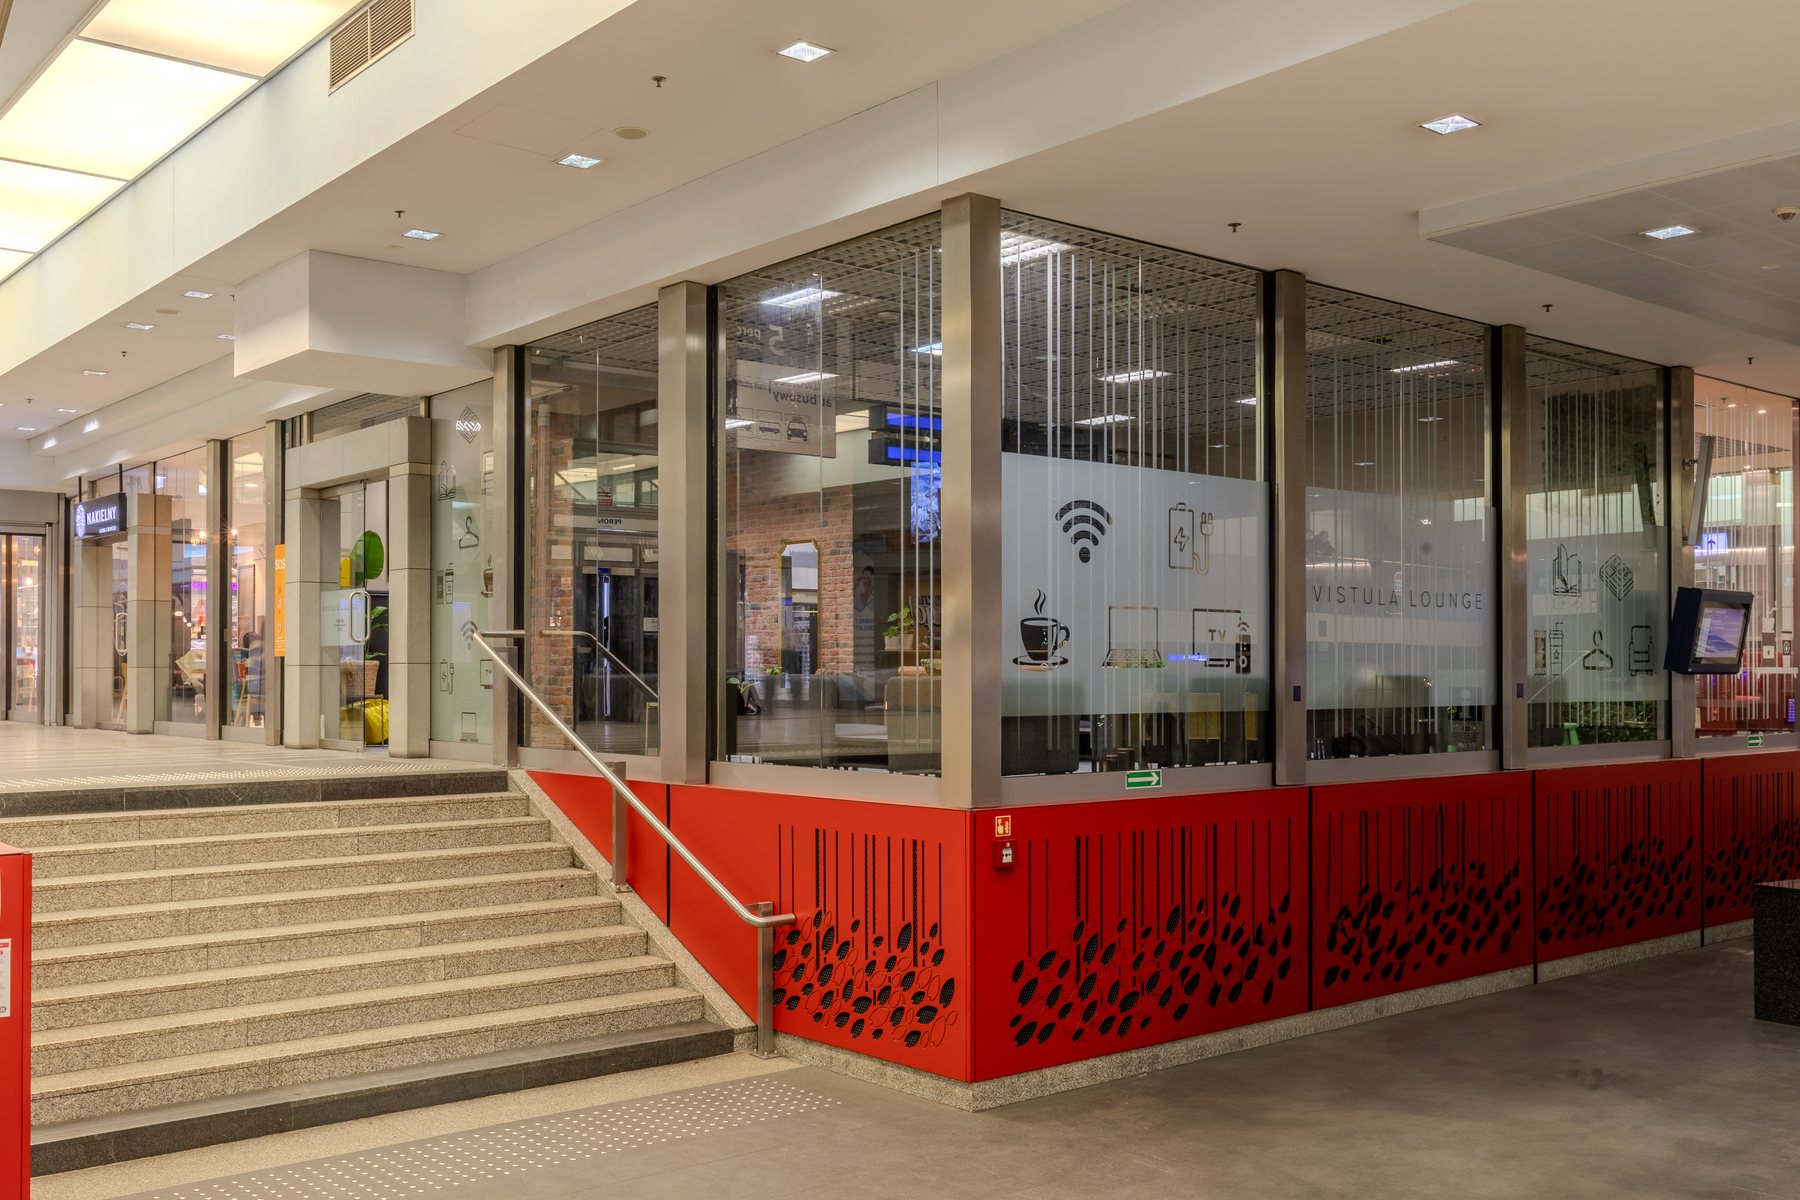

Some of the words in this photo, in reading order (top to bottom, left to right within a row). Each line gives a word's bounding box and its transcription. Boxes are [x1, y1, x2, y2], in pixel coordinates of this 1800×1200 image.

[86, 505, 117, 526] NAKIELNY
[274, 558, 286, 570] SOS
[1313, 585, 1398, 606] VISTULA
[1409, 590, 1483, 610] LOUNGE
[1208, 629, 1226, 641] TV
